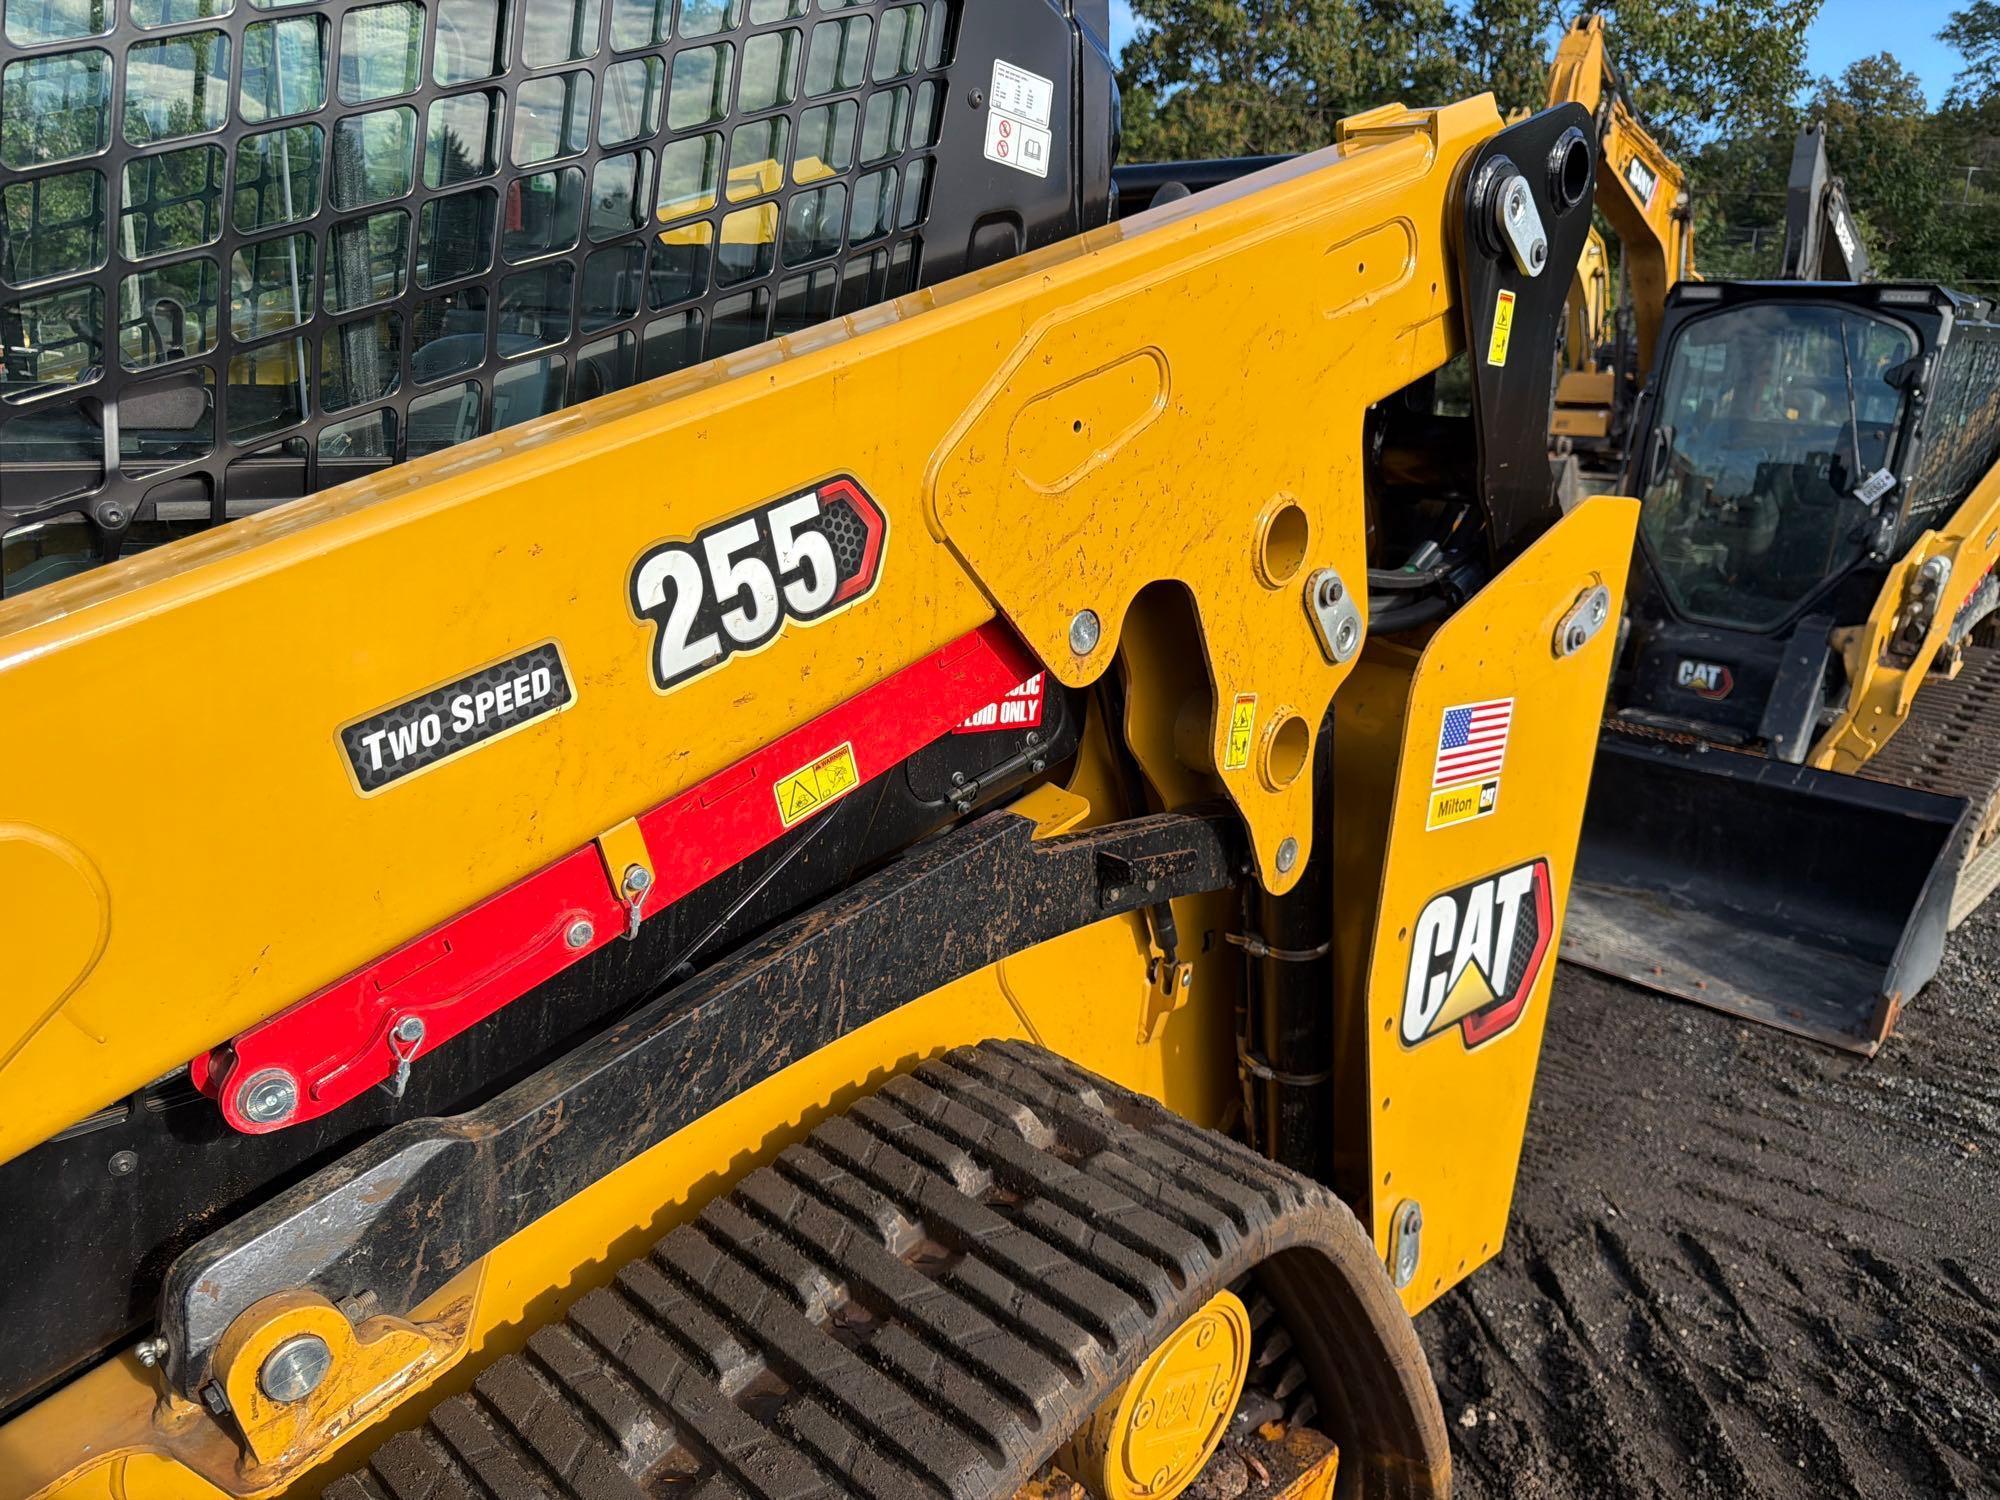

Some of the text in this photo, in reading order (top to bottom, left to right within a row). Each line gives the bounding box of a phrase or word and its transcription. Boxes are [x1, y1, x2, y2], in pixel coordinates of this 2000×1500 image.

[637, 492, 838, 681] 255
[1678, 660, 1721, 690] CAT
[1000, 699, 1039, 724] ONLY
[821, 747, 848, 767] WARNING
[1437, 786, 1495, 818] Milton CAT
[1402, 864, 1534, 1042] CAT
